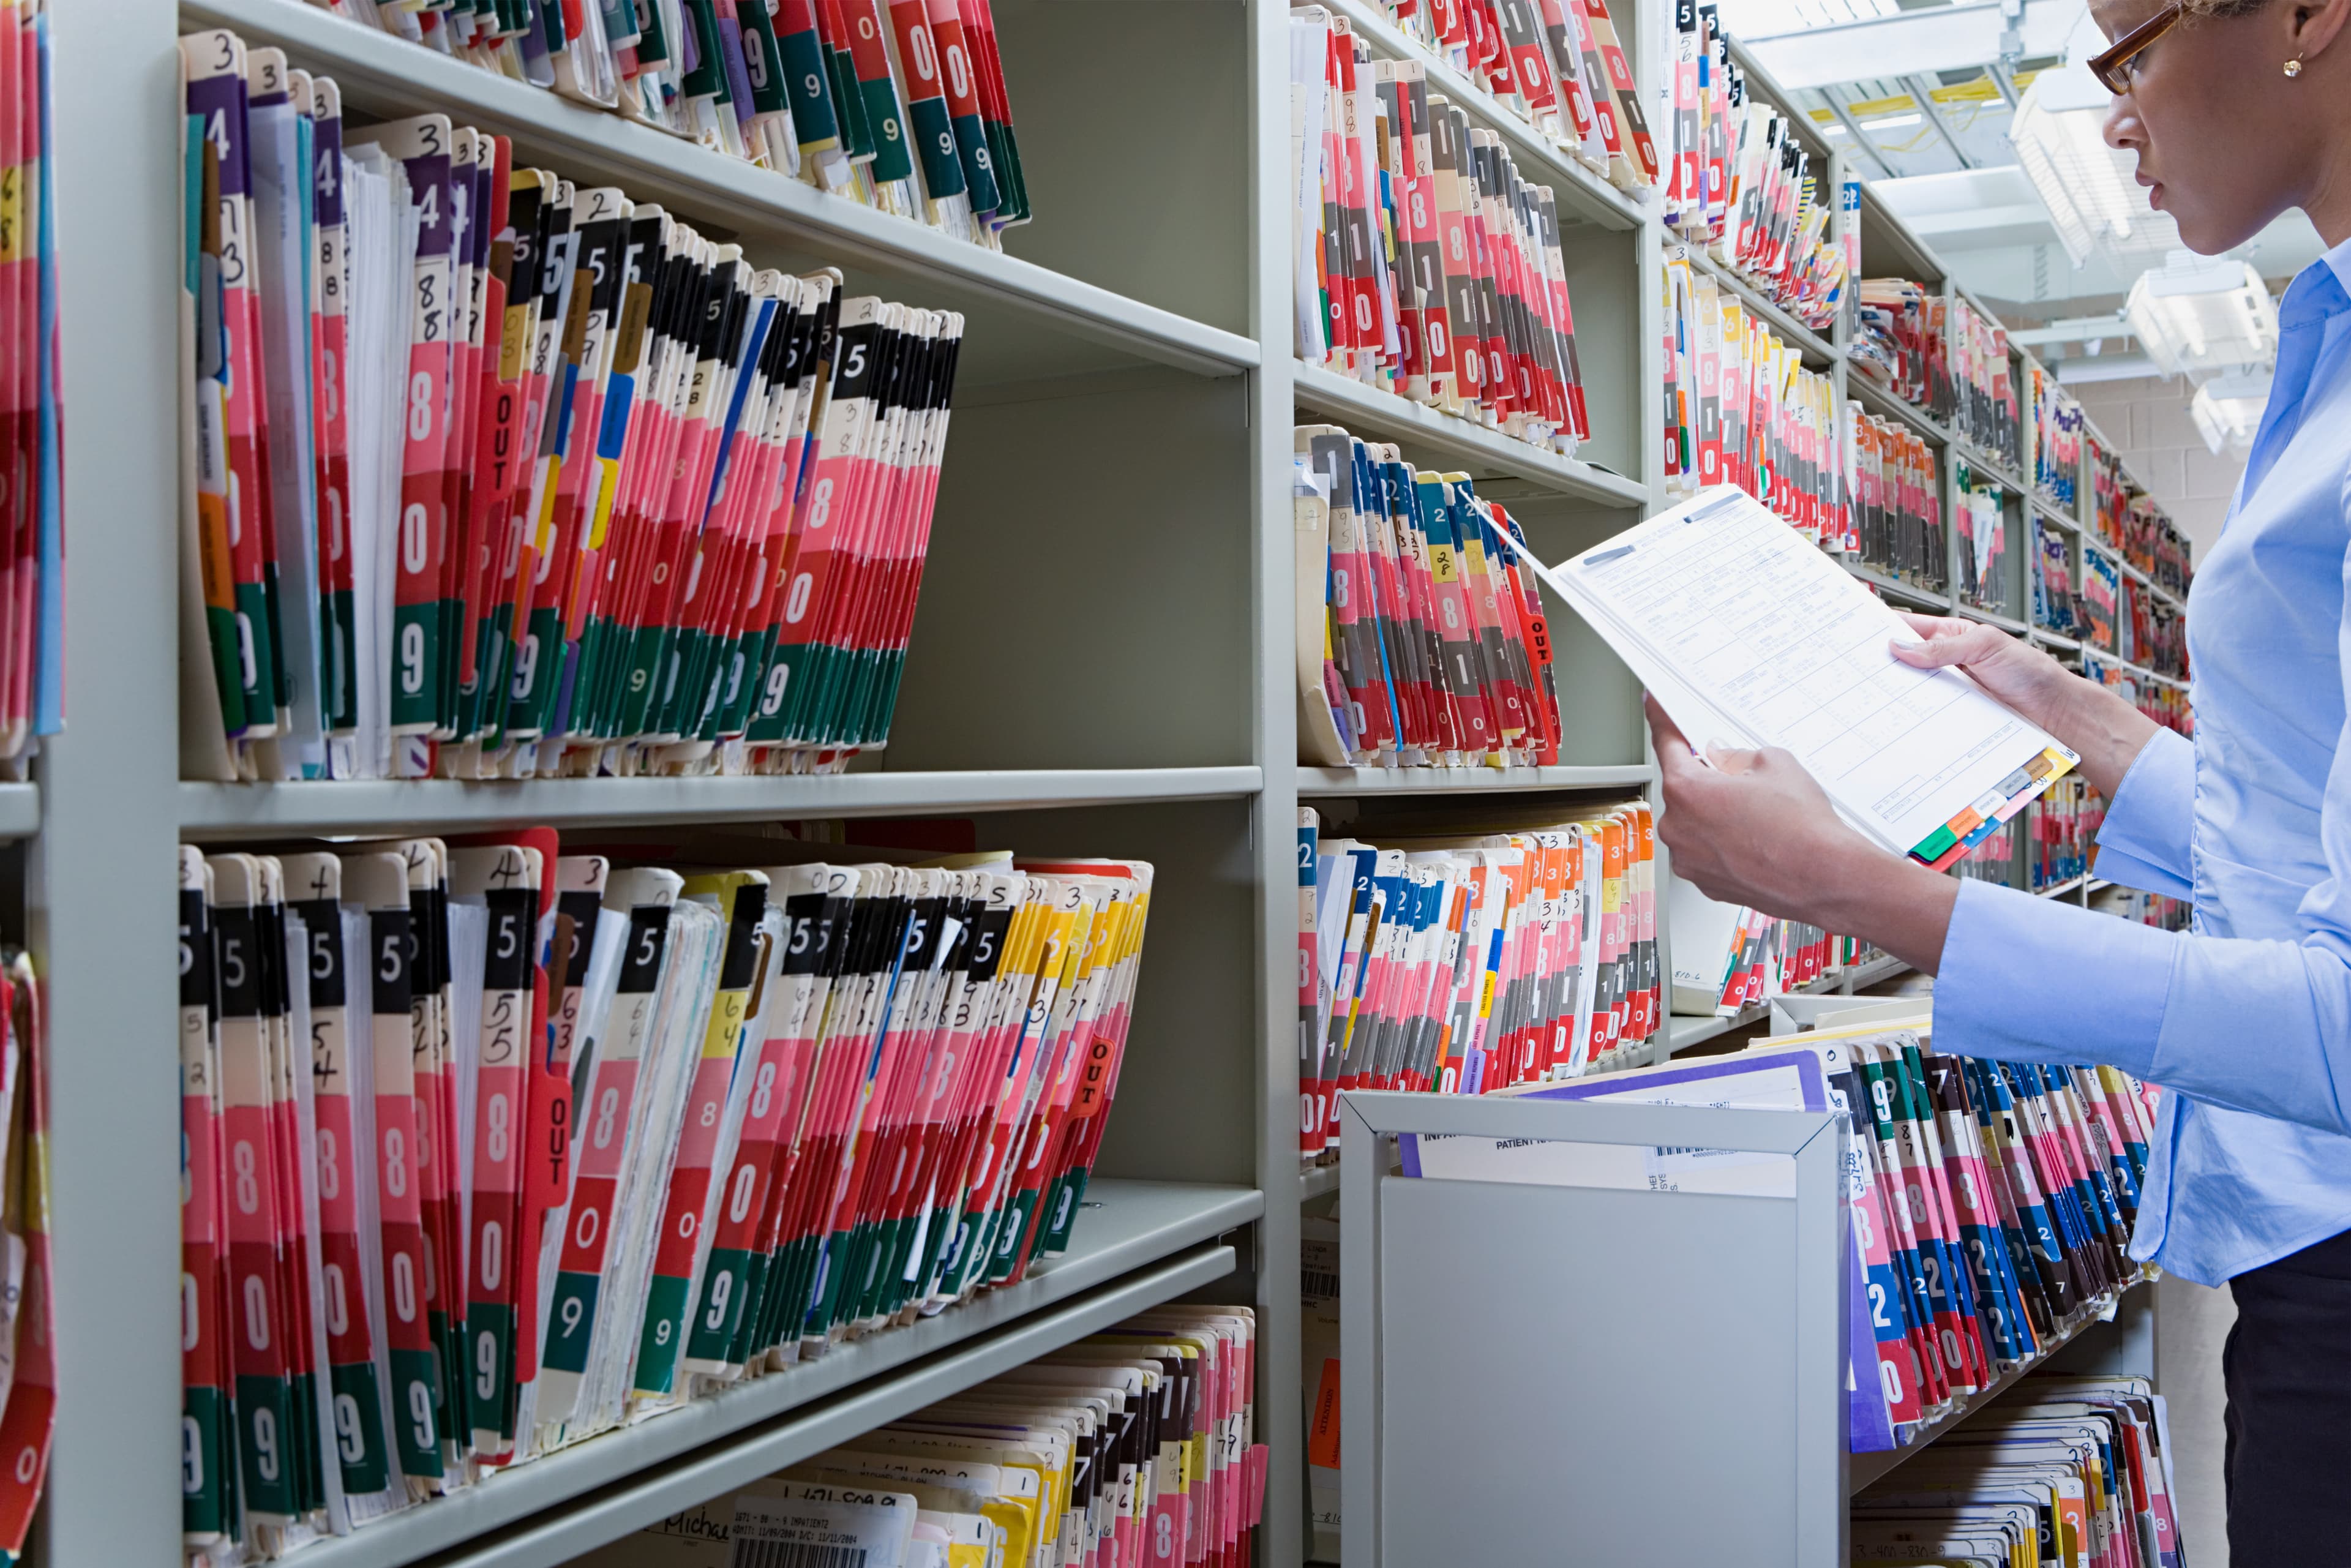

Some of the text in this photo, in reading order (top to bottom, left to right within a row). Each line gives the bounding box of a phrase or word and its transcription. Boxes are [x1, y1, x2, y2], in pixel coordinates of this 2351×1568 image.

[1508, 2, 1523, 32] 1
[1681, 6, 1690, 23] 5
[745, 28, 768, 88] 9
[910, 25, 934, 80] 0
[805, 74, 820, 97] 9
[1524, 58, 1541, 87] 0
[1573, 92, 1588, 122] 0
[1629, 100, 1641, 124] 1
[883, 118, 899, 141] 9
[939, 133, 953, 155] 9
[1438, 119, 1447, 154] 1
[976, 148, 989, 169] 9
[1709, 166, 1720, 191] 0
[421, 184, 439, 228] 4
[1330, 231, 1338, 246] 1
[1450, 227, 1463, 261] 8
[544, 235, 567, 294] 5
[1422, 255, 1433, 290] 1
[1330, 303, 1341, 319] 0
[1355, 294, 1373, 331] 0
[1460, 289, 1470, 323] 1
[1430, 322, 1444, 357] 0
[1724, 316, 1734, 332] 6
[844, 345, 866, 377] 5
[1465, 349, 1478, 383] 0
[1704, 361, 1713, 385] 8
[1665, 392, 1673, 418] 1
[1723, 376, 1734, 400] 8
[410, 372, 432, 440] 8
[1705, 408, 1712, 432] 1
[494, 395, 511, 489] OUT
[1666, 439, 1676, 463] 0
[1704, 450, 1714, 475] 0
[809, 478, 833, 528] 8
[1434, 508, 1446, 522] 2
[403, 503, 427, 573] 0
[786, 573, 812, 623] 0
[1442, 597, 1458, 629] 8
[1485, 596, 1495, 609] 8
[1497, 648, 1505, 659] 1
[1532, 621, 1548, 660] OUT
[401, 623, 424, 693] 9
[1456, 655, 1468, 685] 1
[631, 670, 646, 692] 9
[762, 664, 790, 715] 9
[1507, 697, 1518, 710] 0
[1472, 718, 1484, 730] 0
[1646, 828, 1653, 840] 3
[1298, 844, 1313, 868] 2
[1611, 847, 1619, 858] 3
[1358, 877, 1368, 890] 2
[1547, 869, 1557, 879] 3
[1066, 887, 1080, 907] 3
[1644, 912, 1652, 923] 8
[497, 916, 516, 959] 5
[636, 928, 658, 965] 5
[790, 918, 811, 953] 5
[975, 932, 994, 962] 5
[1607, 934, 1615, 945] 8
[225, 939, 244, 987] 5
[313, 933, 333, 979] 5
[381, 936, 401, 981] 5
[1743, 946, 1752, 965] 1
[1602, 981, 1608, 992] 1
[1636, 1010, 1643, 1021] 0
[1329, 1042, 1336, 1057] 1
[1595, 1031, 1605, 1043] 0
[751, 1062, 776, 1118] 8
[1083, 1044, 1108, 1103] OUT
[1932, 1069, 1948, 1095] 7
[1988, 1074, 2001, 1086] 2
[700, 1103, 716, 1126] 8
[1299, 1093, 1313, 1133] 0
[1872, 1080, 1891, 1121] 9
[488, 1093, 508, 1161] 8
[594, 1089, 619, 1149] 8
[550, 1099, 564, 1184] OUT
[234, 1141, 258, 1214] 8
[385, 1128, 406, 1198] 8
[2011, 1163, 2031, 1193] 8
[730, 1164, 756, 1223] 0
[1959, 1173, 1978, 1209] 8
[2114, 1168, 2133, 1195] 2
[1907, 1184, 1927, 1223] 8
[576, 1208, 599, 1248] 0
[679, 1213, 695, 1237] 0
[999, 1208, 1022, 1254] 9
[2038, 1228, 2051, 1240] 2
[481, 1221, 502, 1290] 0
[1971, 1239, 1991, 1275] 2
[392, 1252, 416, 1322] 0
[1912, 1277, 1925, 1295] 2
[1924, 1257, 1945, 1297] 2
[2055, 1283, 2065, 1293] 7
[244, 1275, 269, 1349] 0
[324, 1264, 348, 1335] 0
[707, 1270, 732, 1330] 9
[1869, 1284, 1891, 1327] 2
[561, 1297, 583, 1338] 9
[655, 1320, 671, 1345] 9
[1989, 1307, 2009, 1342] 2
[477, 1331, 497, 1400] 9
[1940, 1329, 1962, 1368] 0
[1883, 1360, 1903, 1403] 0
[335, 1394, 366, 1463] 9
[409, 1381, 435, 1449] 9
[1319, 1389, 1333, 1435] ATTENTION
[253, 1408, 278, 1480] 9
[1074, 1457, 1090, 1487] 7
[1123, 1474, 1131, 1485] 6
[1120, 1496, 1127, 1508] 6
[1157, 1514, 1171, 1558] 8
[2156, 1518, 2167, 1531] 8
